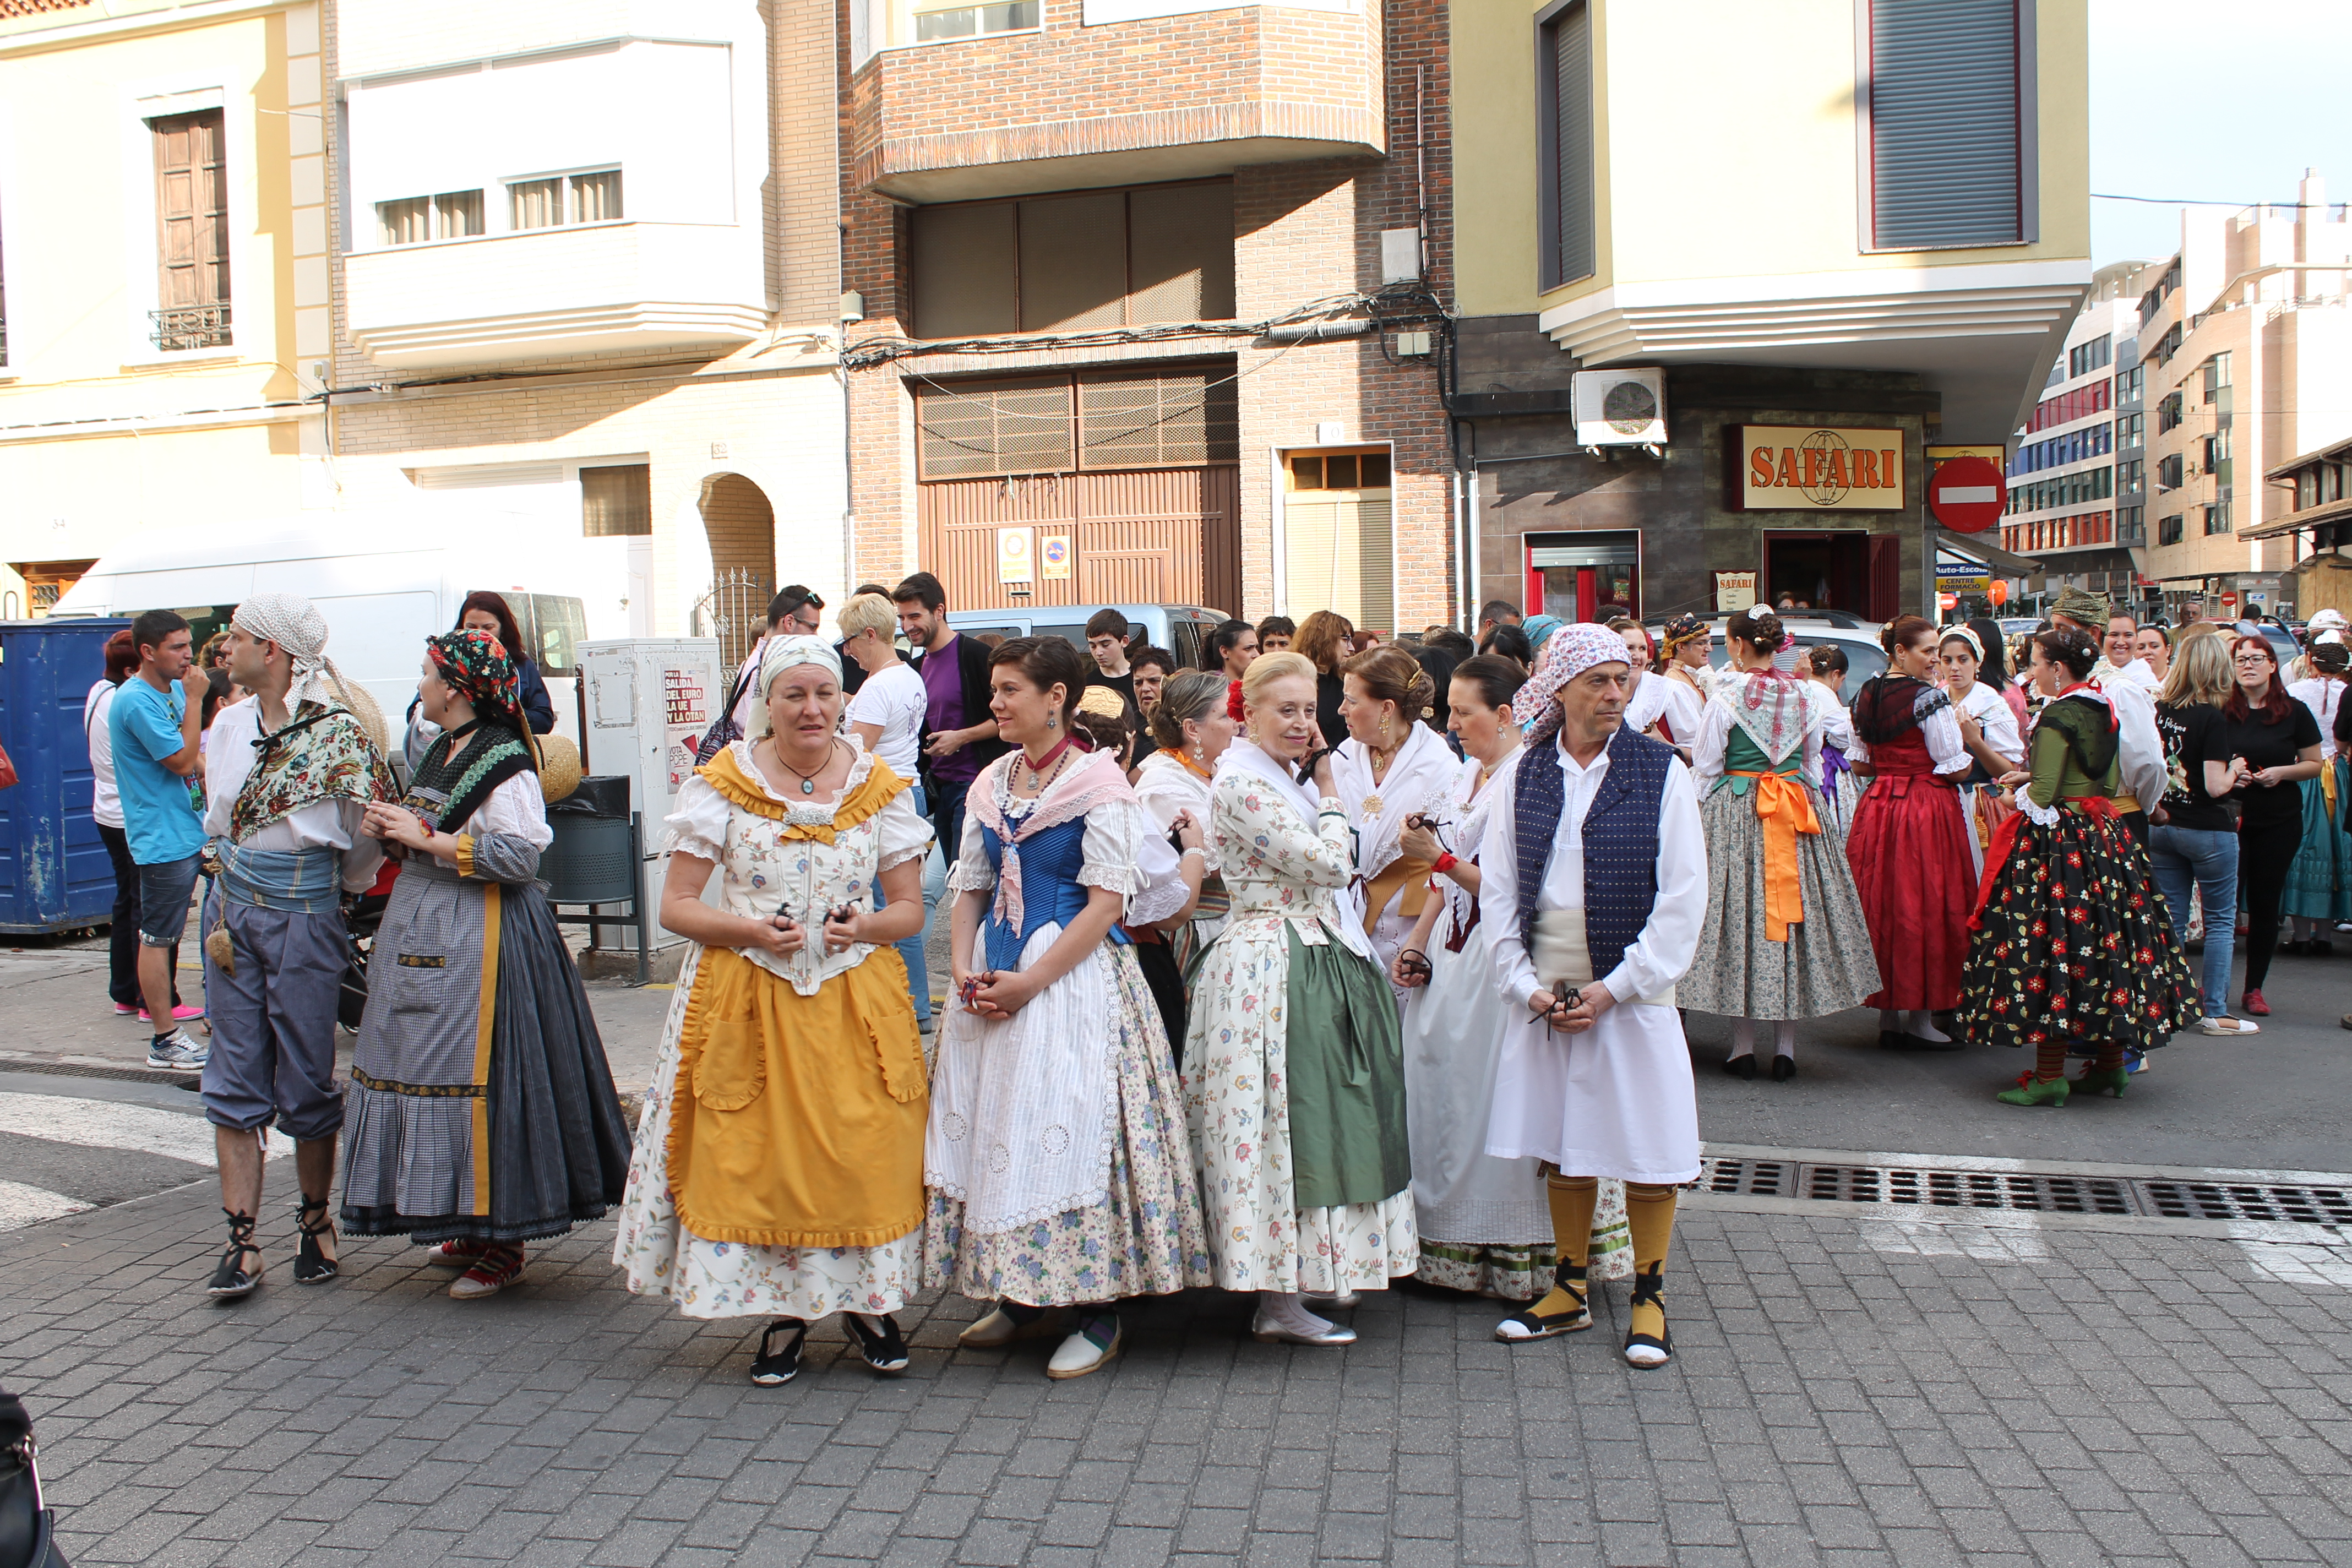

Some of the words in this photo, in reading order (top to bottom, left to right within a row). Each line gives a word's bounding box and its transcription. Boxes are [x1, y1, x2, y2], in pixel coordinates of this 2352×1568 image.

[713, 443, 728, 455] 32
[1750, 446, 1896, 489] SAFARI
[52, 518, 66, 530] 34
[1720, 579, 1752, 588] SAFARI
[666, 678, 692, 689] SALIDA
[666, 690, 680, 700] DEL
[667, 701, 677, 711] LA
[678, 700, 688, 711] UE
[667, 712, 673, 723] Y
[674, 712, 684, 722] LA
[685, 711, 704, 722] OTAN
[668, 745, 683, 754] VOTA
